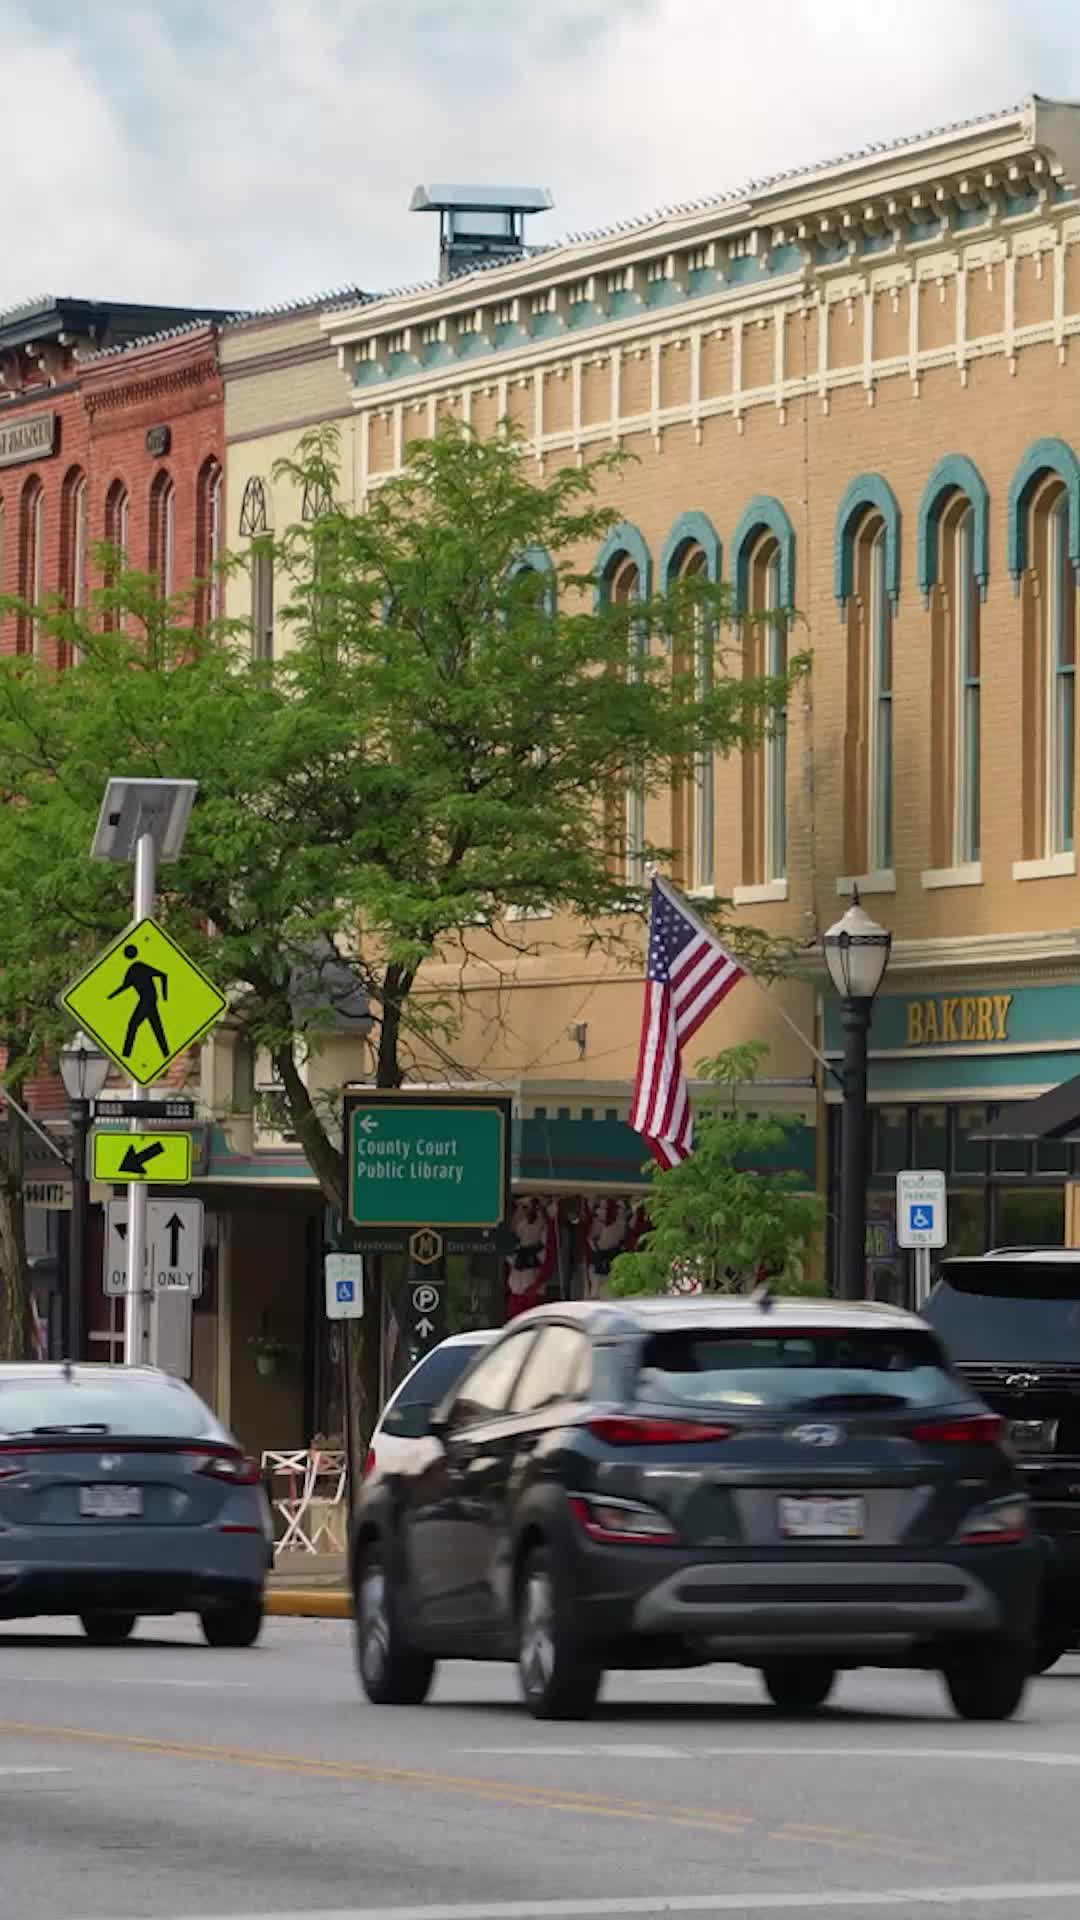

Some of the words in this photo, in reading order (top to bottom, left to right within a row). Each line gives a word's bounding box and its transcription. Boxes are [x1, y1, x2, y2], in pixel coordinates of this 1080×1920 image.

[906, 994, 1012, 1044] BAKERY
[357, 1138, 410, 1159] County
[416, 1138, 457, 1156] Court
[357, 1161, 405, 1178] Public
[410, 1161, 464, 1184] Library
[158, 1271, 193, 1286] ONLY
[419, 1290, 434, 1308] P
